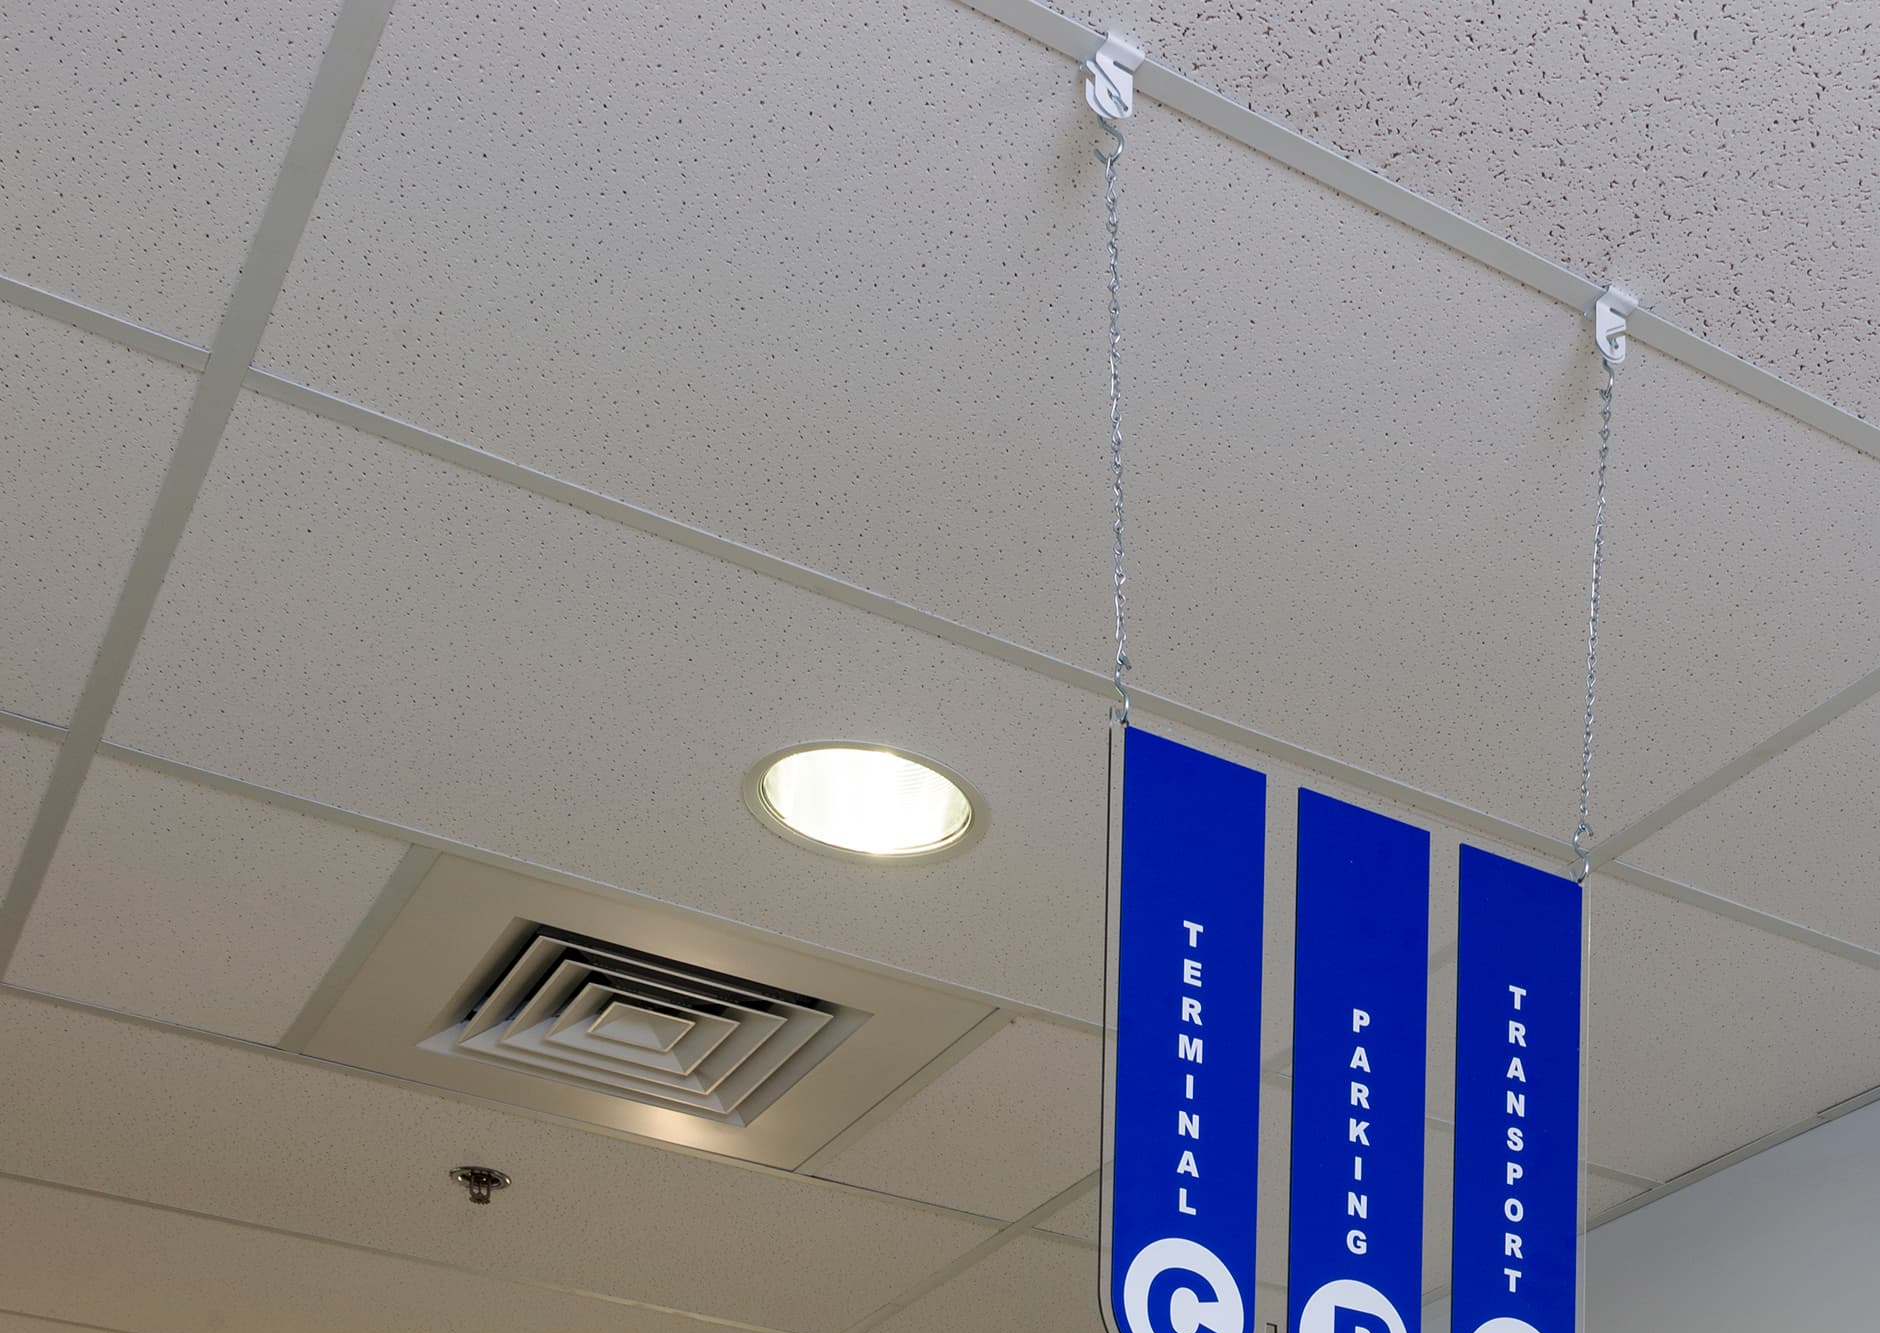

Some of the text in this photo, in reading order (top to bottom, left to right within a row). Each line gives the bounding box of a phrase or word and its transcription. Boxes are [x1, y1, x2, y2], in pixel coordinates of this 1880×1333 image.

[1176, 919, 1204, 1216] TERMINAL
[1346, 1008, 1371, 1255] PARKING
[1503, 984, 1527, 1293] TRANSPORT
